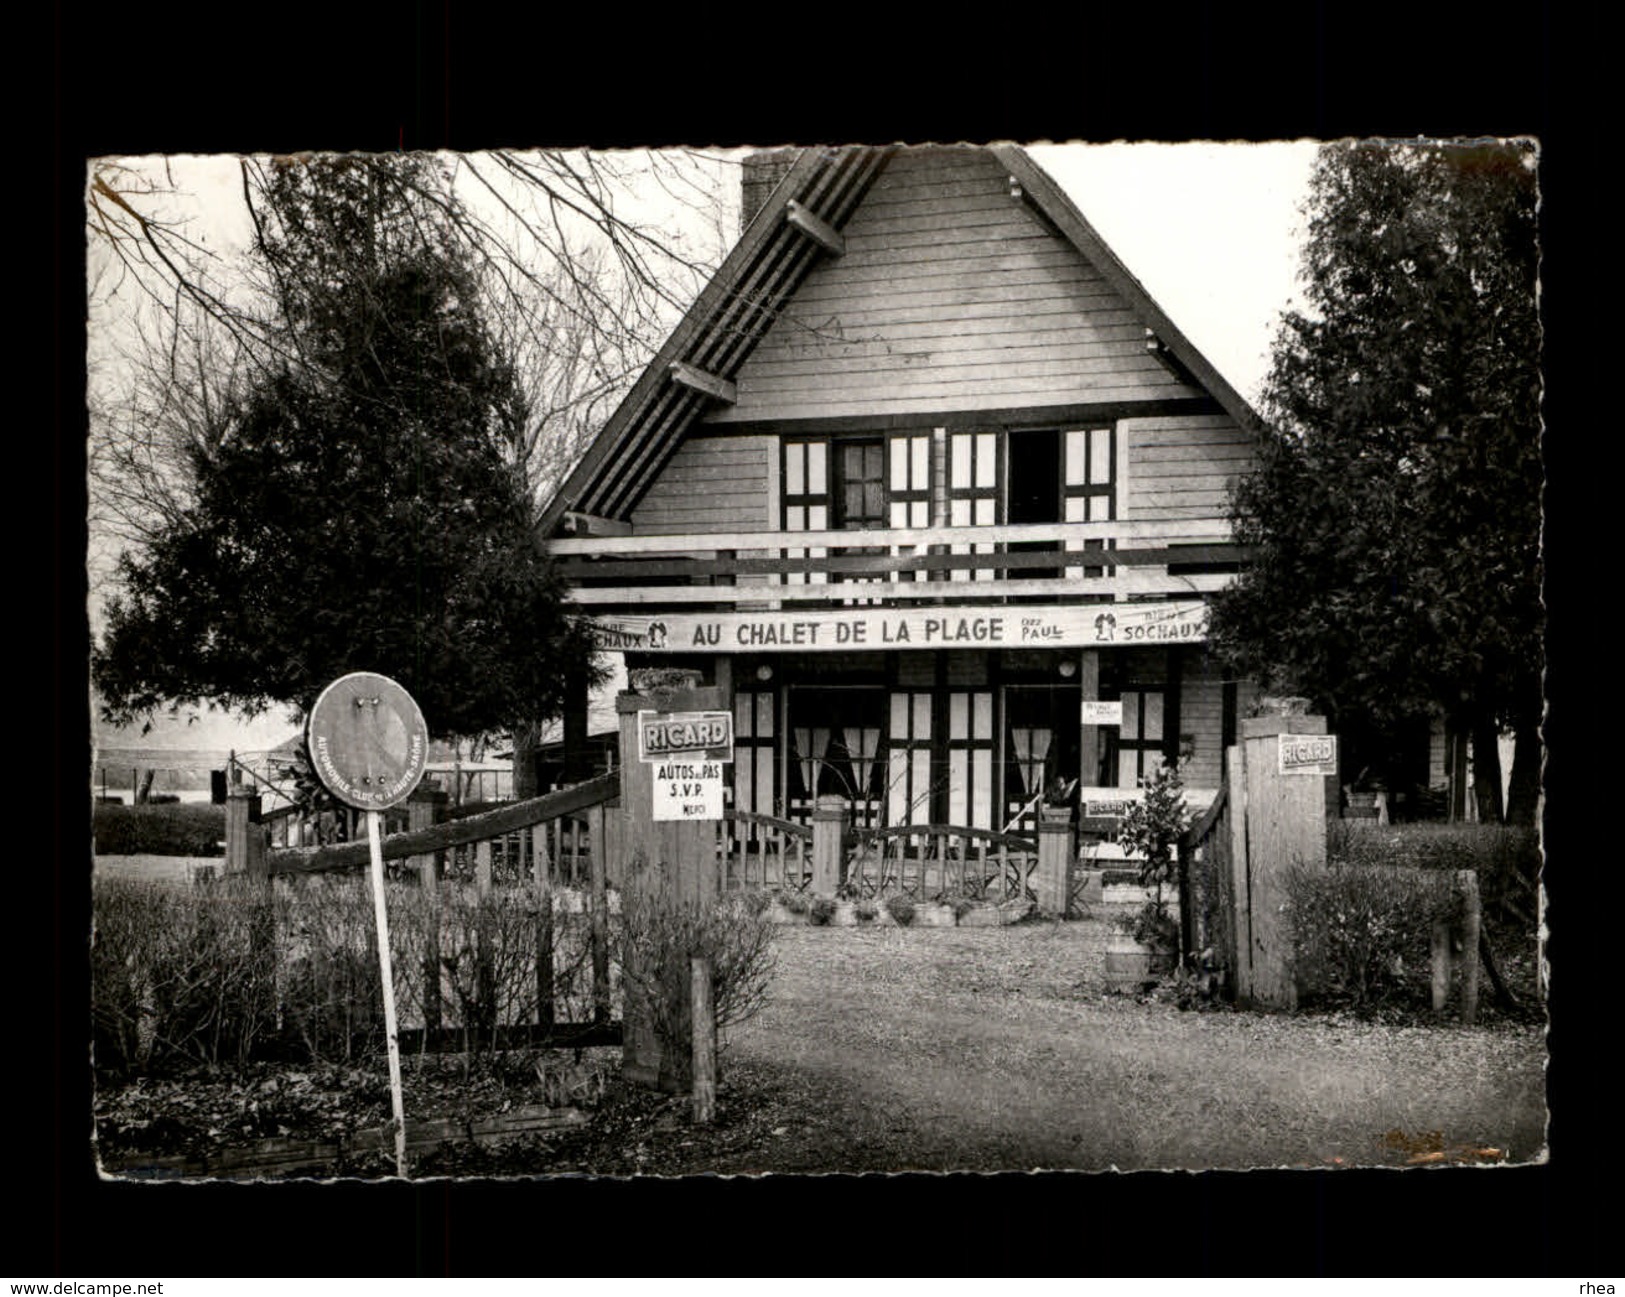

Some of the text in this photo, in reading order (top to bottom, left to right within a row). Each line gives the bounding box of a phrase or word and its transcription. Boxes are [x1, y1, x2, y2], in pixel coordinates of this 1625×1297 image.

[693, 618, 1003, 645] AU CHALET DE LA PLAGE
[1022, 625, 1064, 641] PAUL
[1124, 624, 1202, 641] SOCHAUX
[593, 632, 642, 649] CHAUX
[646, 722, 727, 749] RICARD
[317, 736, 350, 794] AUTOMOBILE
[658, 764, 694, 781] AUTOS
[702, 764, 720, 780] PAS
[669, 783, 705, 797] S.V.P.
